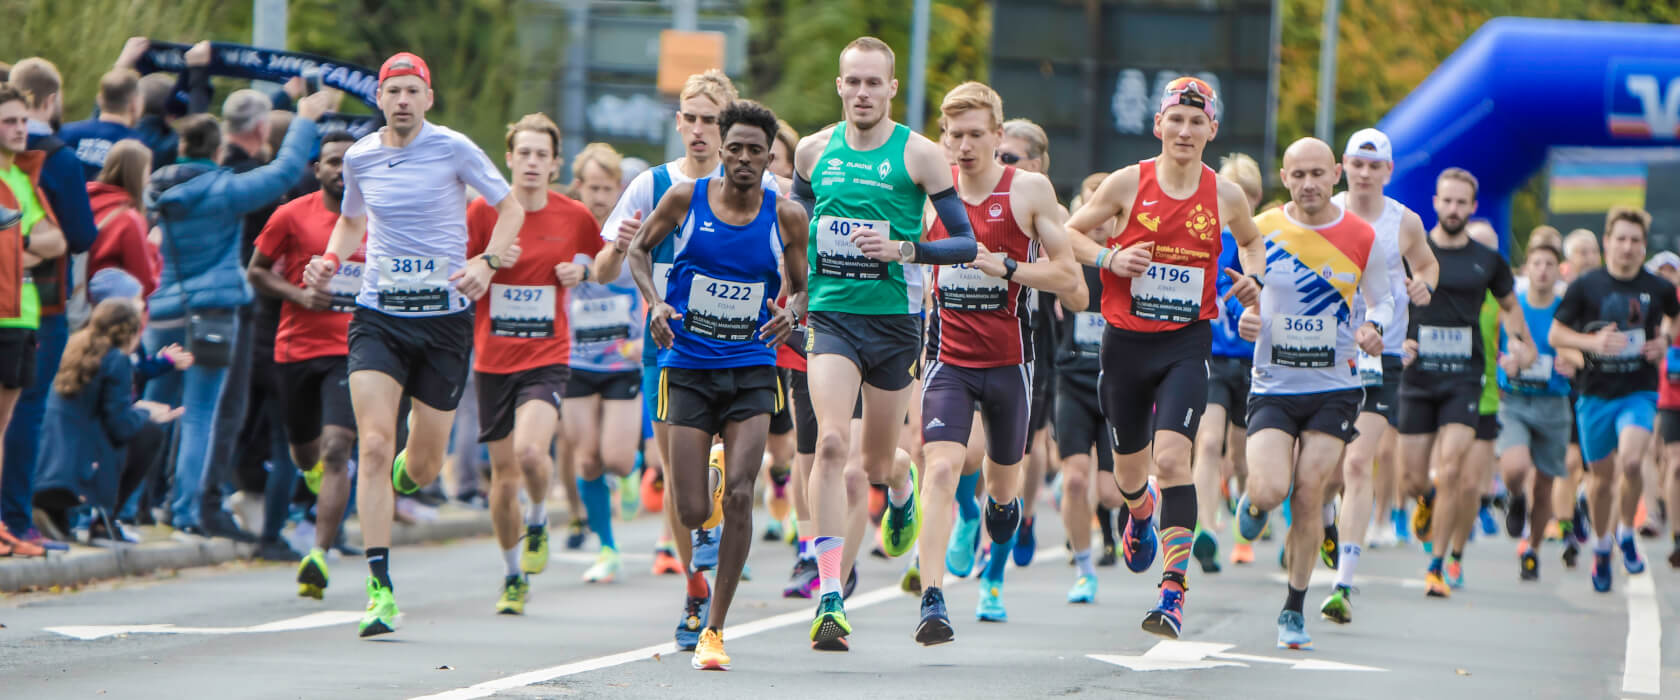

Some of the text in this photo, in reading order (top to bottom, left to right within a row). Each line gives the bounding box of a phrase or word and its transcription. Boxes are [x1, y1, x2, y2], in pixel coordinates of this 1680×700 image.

[391, 259, 435, 273] 3814
[1147, 265, 1190, 284] 4196
[503, 288, 543, 302] 4297
[706, 282, 752, 301] 4222
[1284, 317, 1324, 332] 3663
